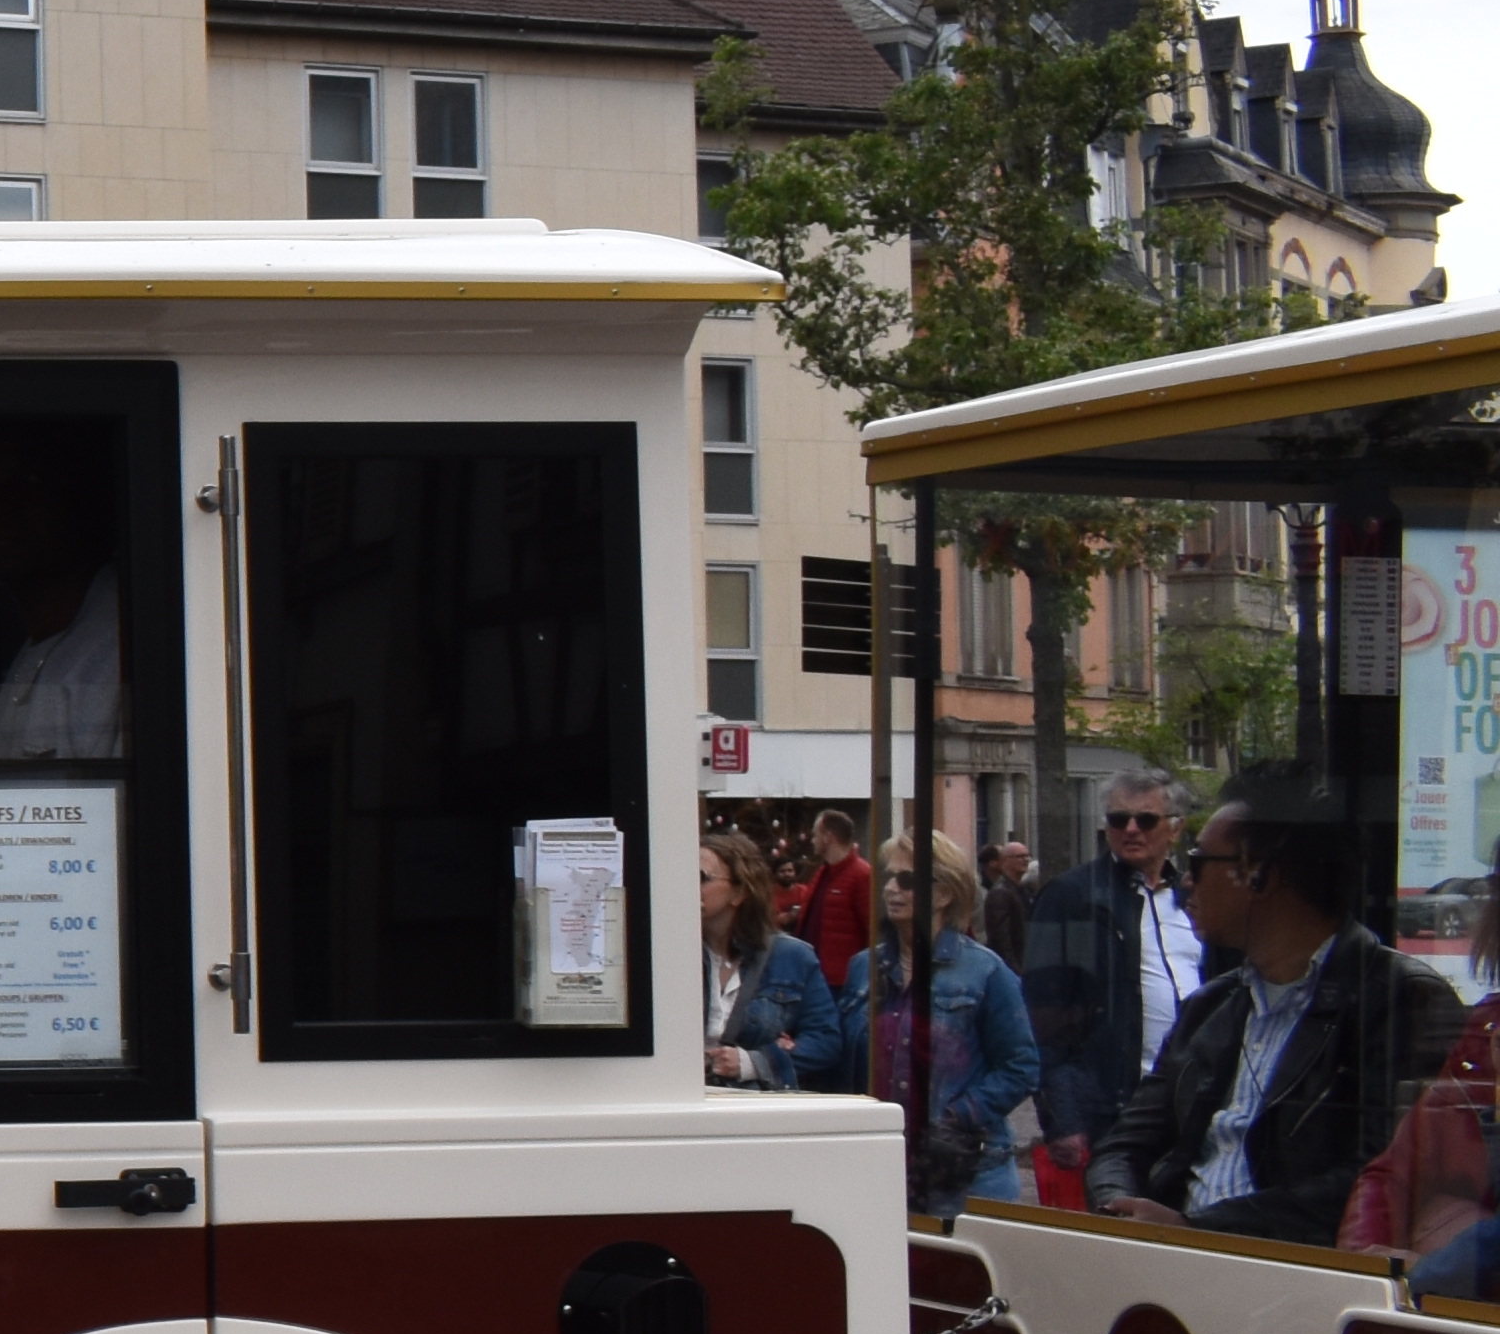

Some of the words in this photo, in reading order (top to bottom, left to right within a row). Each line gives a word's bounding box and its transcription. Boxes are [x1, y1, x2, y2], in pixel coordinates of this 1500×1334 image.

[1455, 546, 1476, 595] 3
[19, 805, 27, 823] /
[32, 807, 82, 820] RATES
[1411, 815, 1447, 830] Offres
[49, 860, 82, 875] 8,00
[87, 860, 96, 873] €
[50, 917, 83, 932] 6,00
[88, 917, 97, 930] €
[52, 1018, 84, 1034] 6,50
[90, 1018, 99, 1030] €
